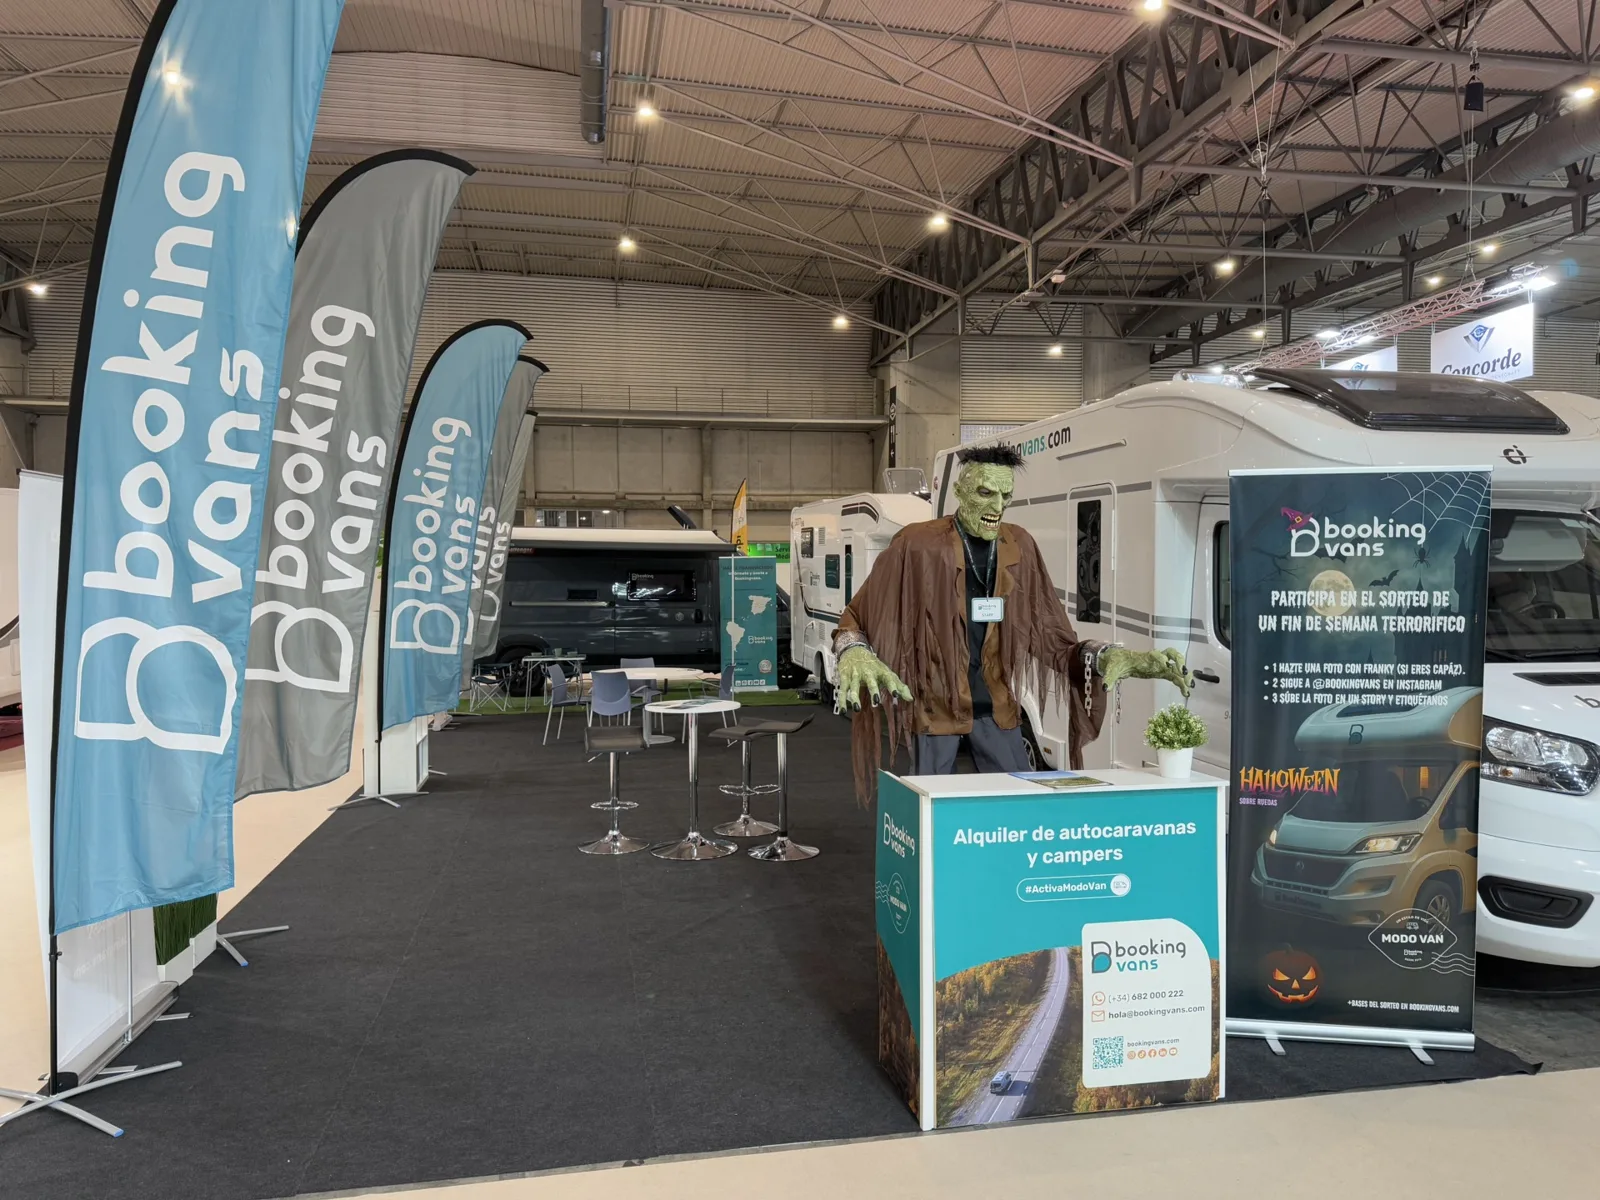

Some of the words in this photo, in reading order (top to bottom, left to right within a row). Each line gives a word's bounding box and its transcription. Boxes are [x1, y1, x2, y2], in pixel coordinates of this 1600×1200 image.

[83, 151, 246, 598] booking
[256, 304, 376, 590] booking
[191, 346, 264, 603] vans
[321, 430, 388, 594] vans
[394, 416, 472, 593] booking
[1324, 516, 1426, 545] booking
[441, 493, 477, 594] vans
[487, 521, 511, 584] vans
[1324, 541, 1385, 557] vans
[1271, 590, 1336, 608] PARTICIPA
[1340, 590, 1357, 607] EN
[1361, 590, 1376, 607] EL
[1379, 590, 1429, 608] SORTEO
[1432, 590, 1450, 607] DE
[1258, 614, 1277, 632] UN
[1281, 615, 1302, 632] FIN
[1305, 615, 1322, 631] DE
[1325, 615, 1378, 633] SEMANA
[1381, 615, 1466, 633] TERRORIFICO
[1272, 663, 1277, 673] 1
[1279, 663, 1303, 674] HAZTE
[1304, 663, 1321, 674] UNA
[1323, 663, 1343, 674] FOTO
[1345, 663, 1361, 674] CON
[1363, 663, 1395, 675] FRANKY
[1397, 663, 1409, 675] (SI
[1411, 664, 1431, 675] ERES
[1272, 677, 1278, 688] 2
[1280, 678, 1303, 689] SIGUE
[1304, 678, 1310, 688] A
[1312, 678, 1381, 690] @BOOKINGVANS
[1383, 679, 1394, 690] EN
[1396, 679, 1442, 691] INSTAGRAM
[1272, 693, 1278, 703] 3
[1302, 693, 1312, 703] LA
[1313, 693, 1333, 704] FOTO
[1335, 693, 1346, 704] EN
[1348, 694, 1359, 705] UN
[1361, 694, 1386, 705] STORY
[1388, 694, 1394, 705] Y
[1239, 797, 1256, 805] SOBRE
[1257, 798, 1278, 806] RUEDAS
[890, 817, 915, 856] booking
[953, 826, 1028, 847] Alquiler
[1032, 826, 1055, 841] de
[1059, 821, 1197, 840] autocaravanas
[891, 838, 905, 858] vans
[1026, 852, 1038, 868] y
[1042, 848, 1123, 865] campers
[1025, 881, 1107, 894] #ActivaModoVan
[1381, 933, 1417, 944] MODO
[1419, 934, 1444, 944] VAN
[1115, 938, 1186, 959] booking
[1116, 959, 1158, 972] vans
[1108, 993, 1130, 1003] (+34)
[1131, 993, 1148, 1001] 682
[1149, 991, 1167, 1000] 000
[1168, 989, 1184, 997] 222
[1108, 1005, 1206, 1019] hola@bookingvans.com
[1369, 1001, 1379, 1009] DEL
[1380, 1001, 1400, 1010] SORTEO
[1409, 1003, 1460, 1013] BOOKINGVANS.COM
[1127, 1038, 1180, 1047] bookingvans.com
